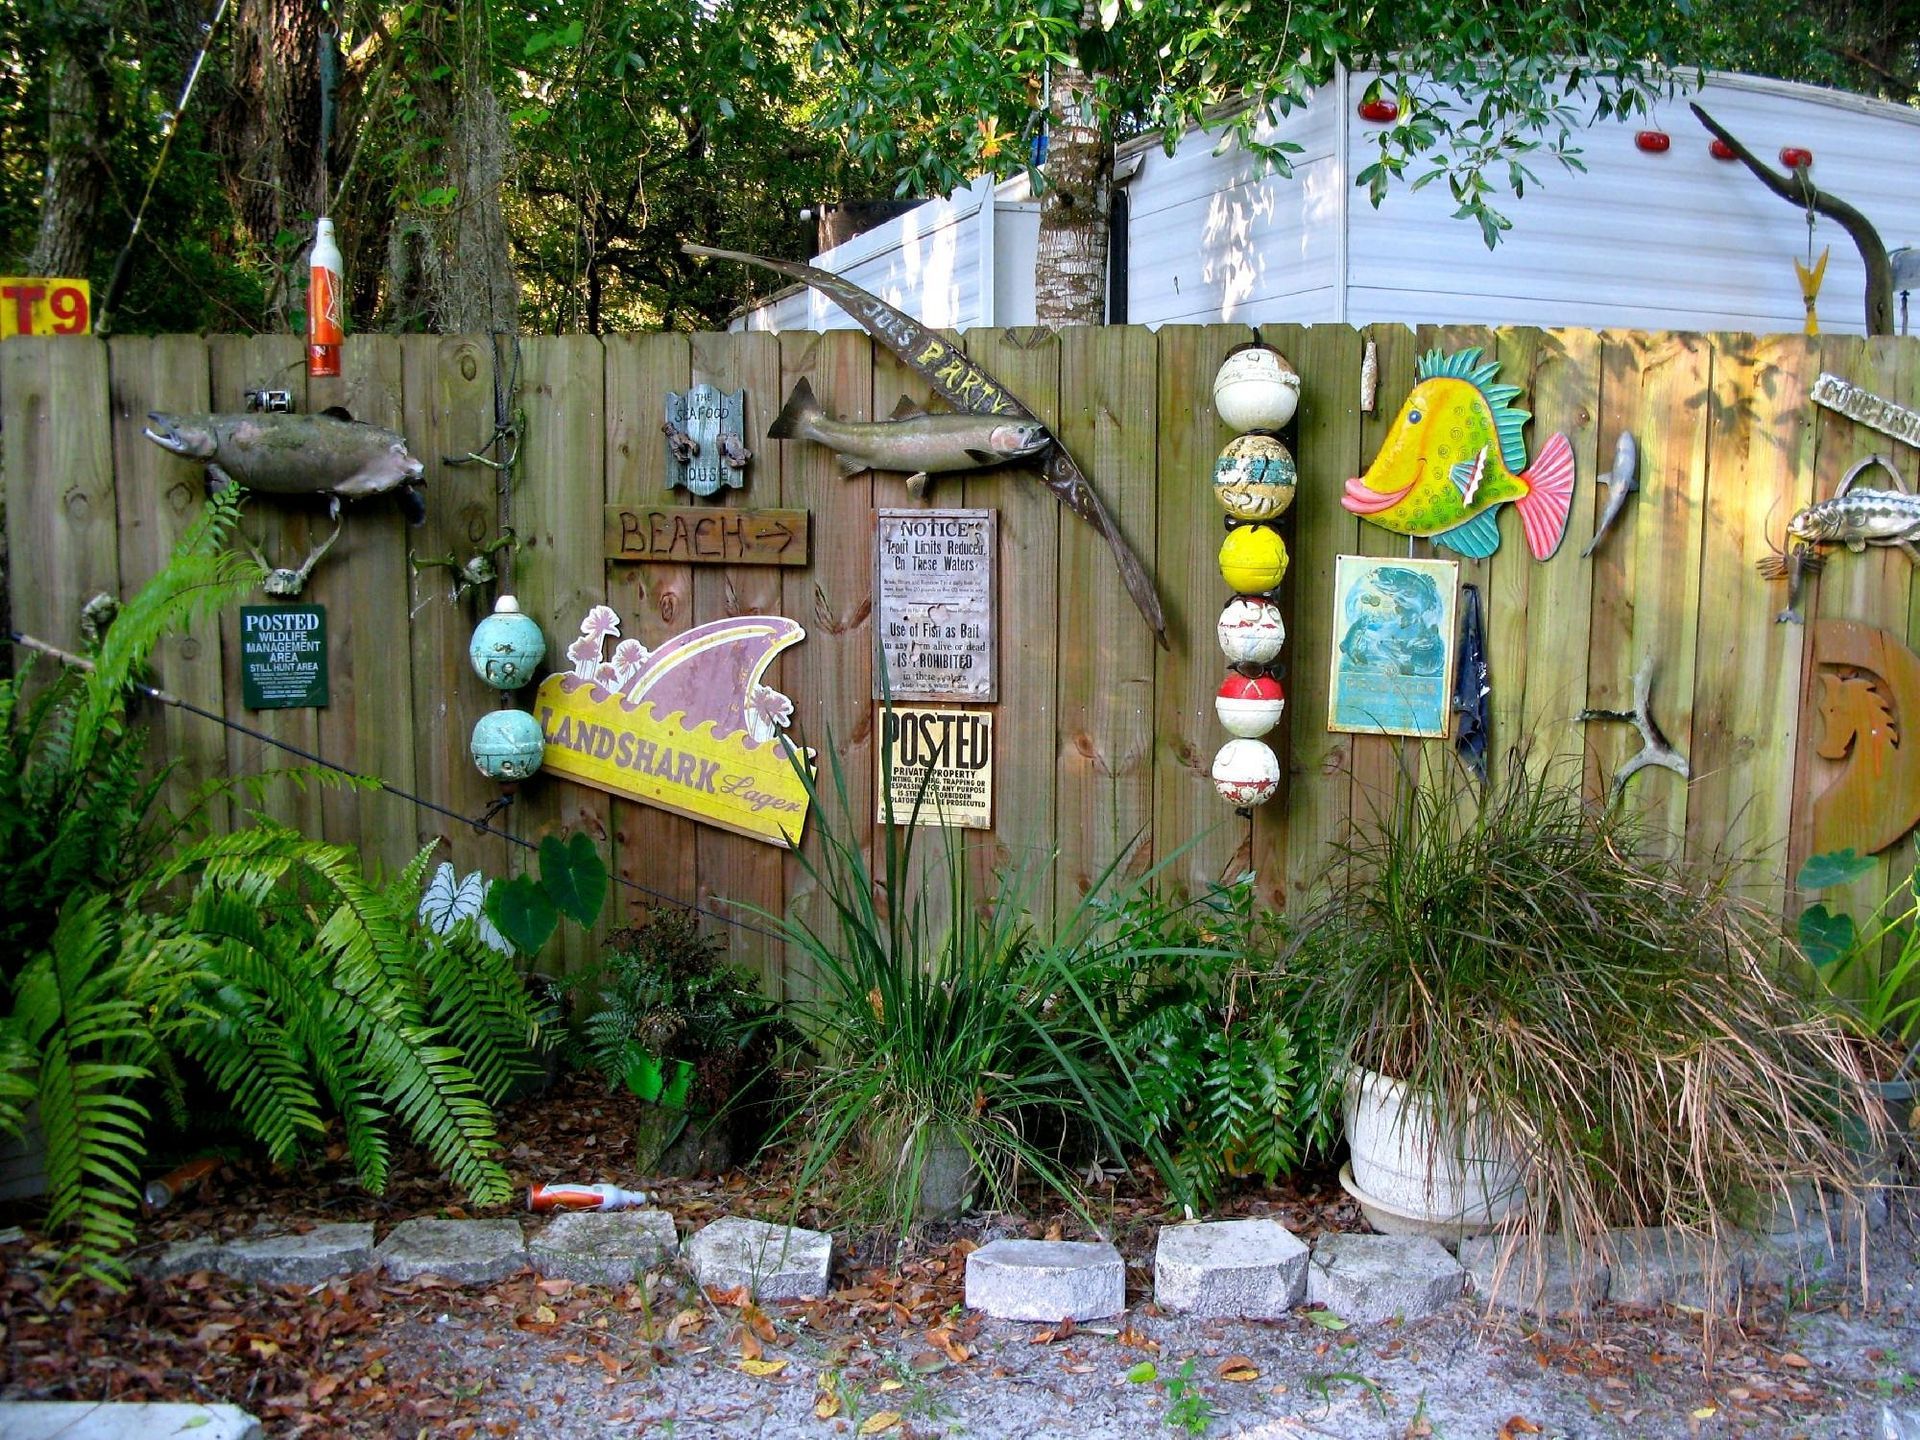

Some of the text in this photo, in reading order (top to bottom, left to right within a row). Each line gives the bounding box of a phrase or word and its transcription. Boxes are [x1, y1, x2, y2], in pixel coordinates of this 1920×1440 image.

[3, 286, 88, 336] T9
[917, 339, 1013, 414] PARTY
[695, 393, 712, 402] THE
[674, 405, 730, 423] SEAFOOD
[677, 467, 729, 482] HOUSE
[619, 512, 744, 559] BEACH
[900, 522, 969, 537] NOTICE
[914, 540, 942, 555] Limits
[894, 556, 906, 571] On
[943, 556, 975, 571] Waters
[246, 613, 320, 632] POSTED
[259, 631, 308, 642] WILDLIFE
[890, 623, 907, 637] Use
[909, 623, 919, 637] of
[945, 626, 956, 638] as
[960, 624, 980, 638] Bait
[246, 641, 321, 653] MANAGEMENT
[932, 641, 953, 651] alive
[966, 641, 986, 652] dead
[269, 652, 299, 663] AREA
[897, 653, 907, 668] IS
[250, 662, 319, 673] STILL HUNT AREA
[882, 712, 989, 770] POSTED
[540, 706, 721, 795] LANDSHARK
[720, 774, 801, 813] Lager
[933, 768, 976, 779] PROPERTY
[943, 778, 975, 786] TRAPPING
[946, 799, 986, 808] PROSECUTED
